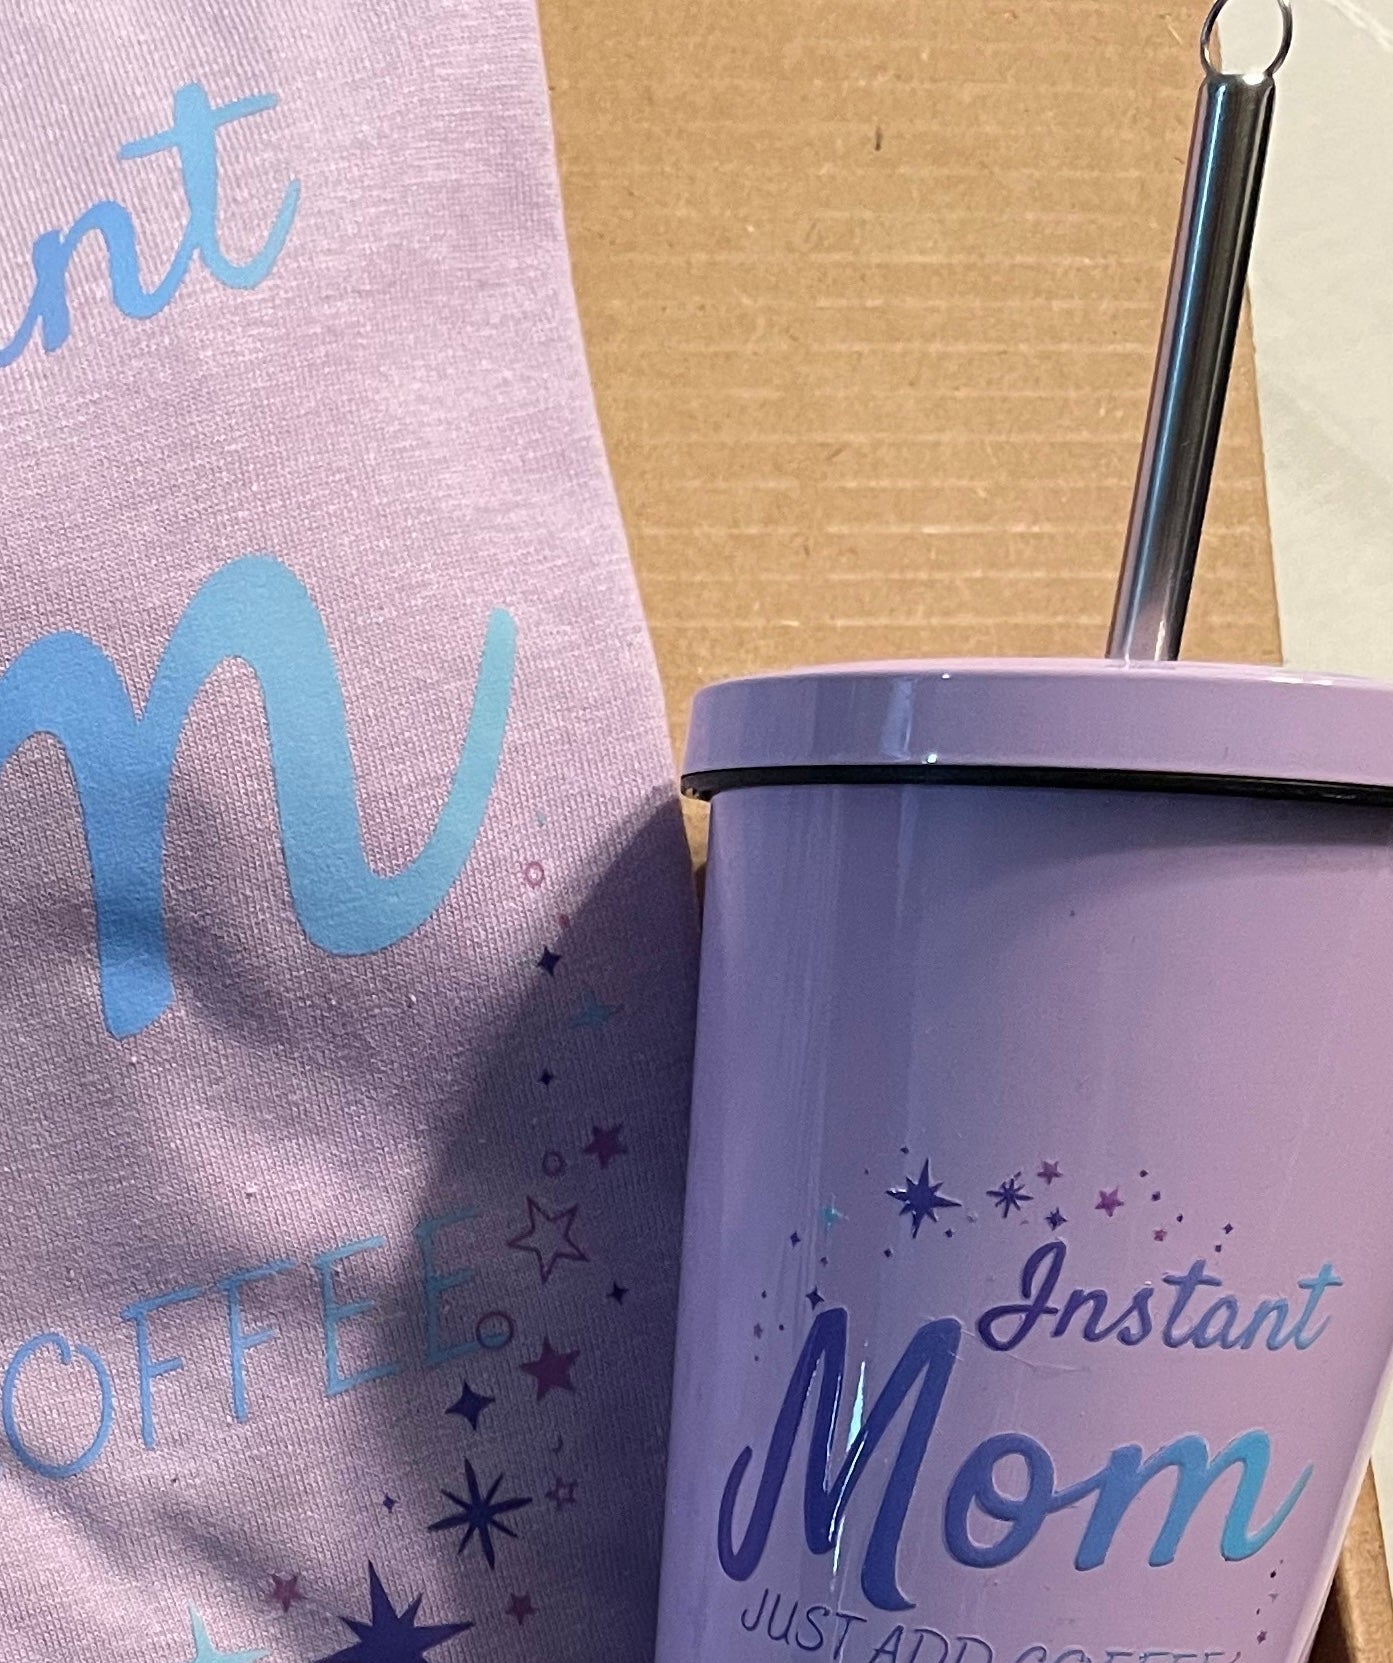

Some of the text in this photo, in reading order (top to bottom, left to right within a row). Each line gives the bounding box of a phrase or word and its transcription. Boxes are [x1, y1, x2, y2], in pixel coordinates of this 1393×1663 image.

[977, 1241, 1344, 1352] Instant
[717, 1307, 1314, 1611] Mom
[740, 1589, 867, 1661] JUST
